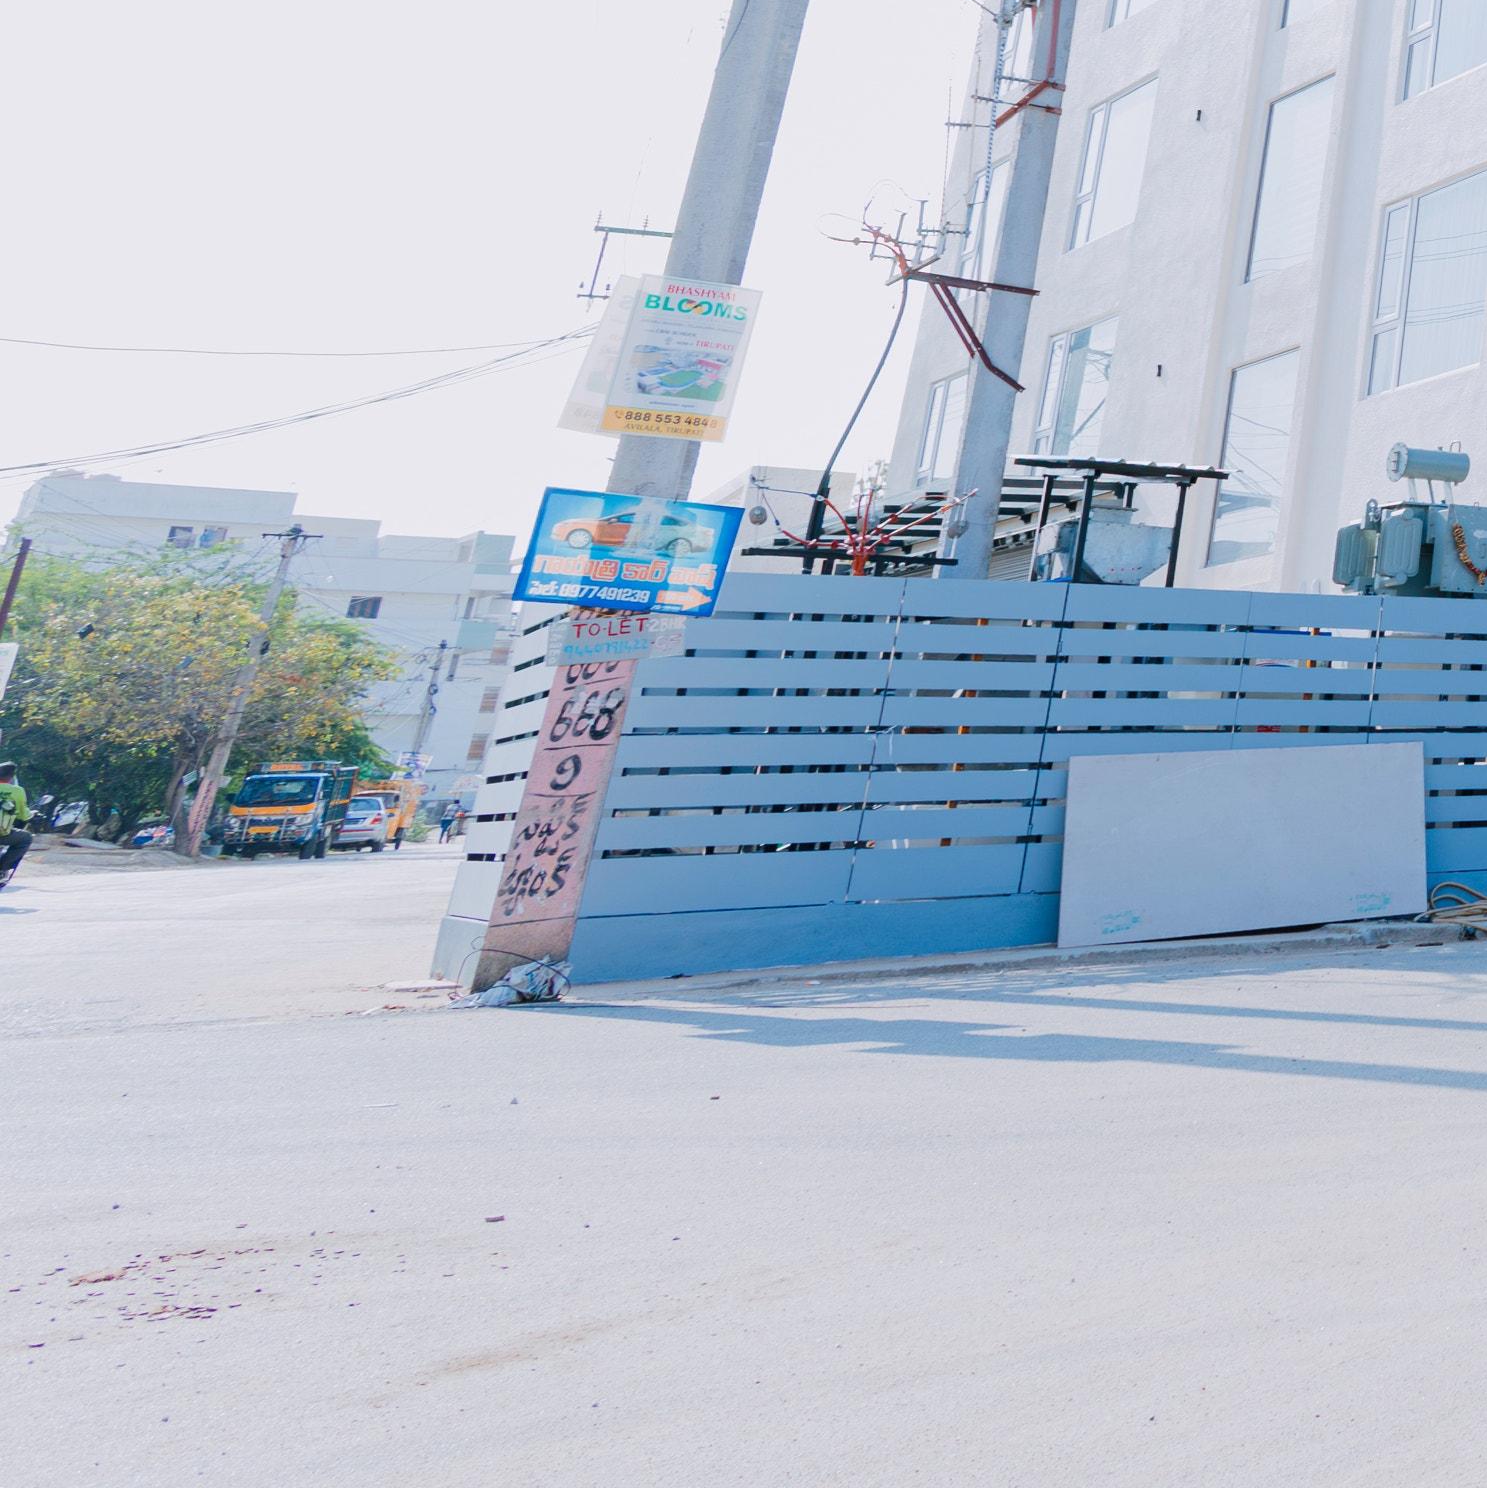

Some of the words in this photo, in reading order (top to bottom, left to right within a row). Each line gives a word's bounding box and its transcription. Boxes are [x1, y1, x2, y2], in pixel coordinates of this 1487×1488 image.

[667, 284, 736, 301] BHASHYAM
[644, 294, 748, 321] BLOOMS
[625, 411, 650, 422] 888
[655, 414, 681, 424] 553
[622, 559, 669, 582] కార్
